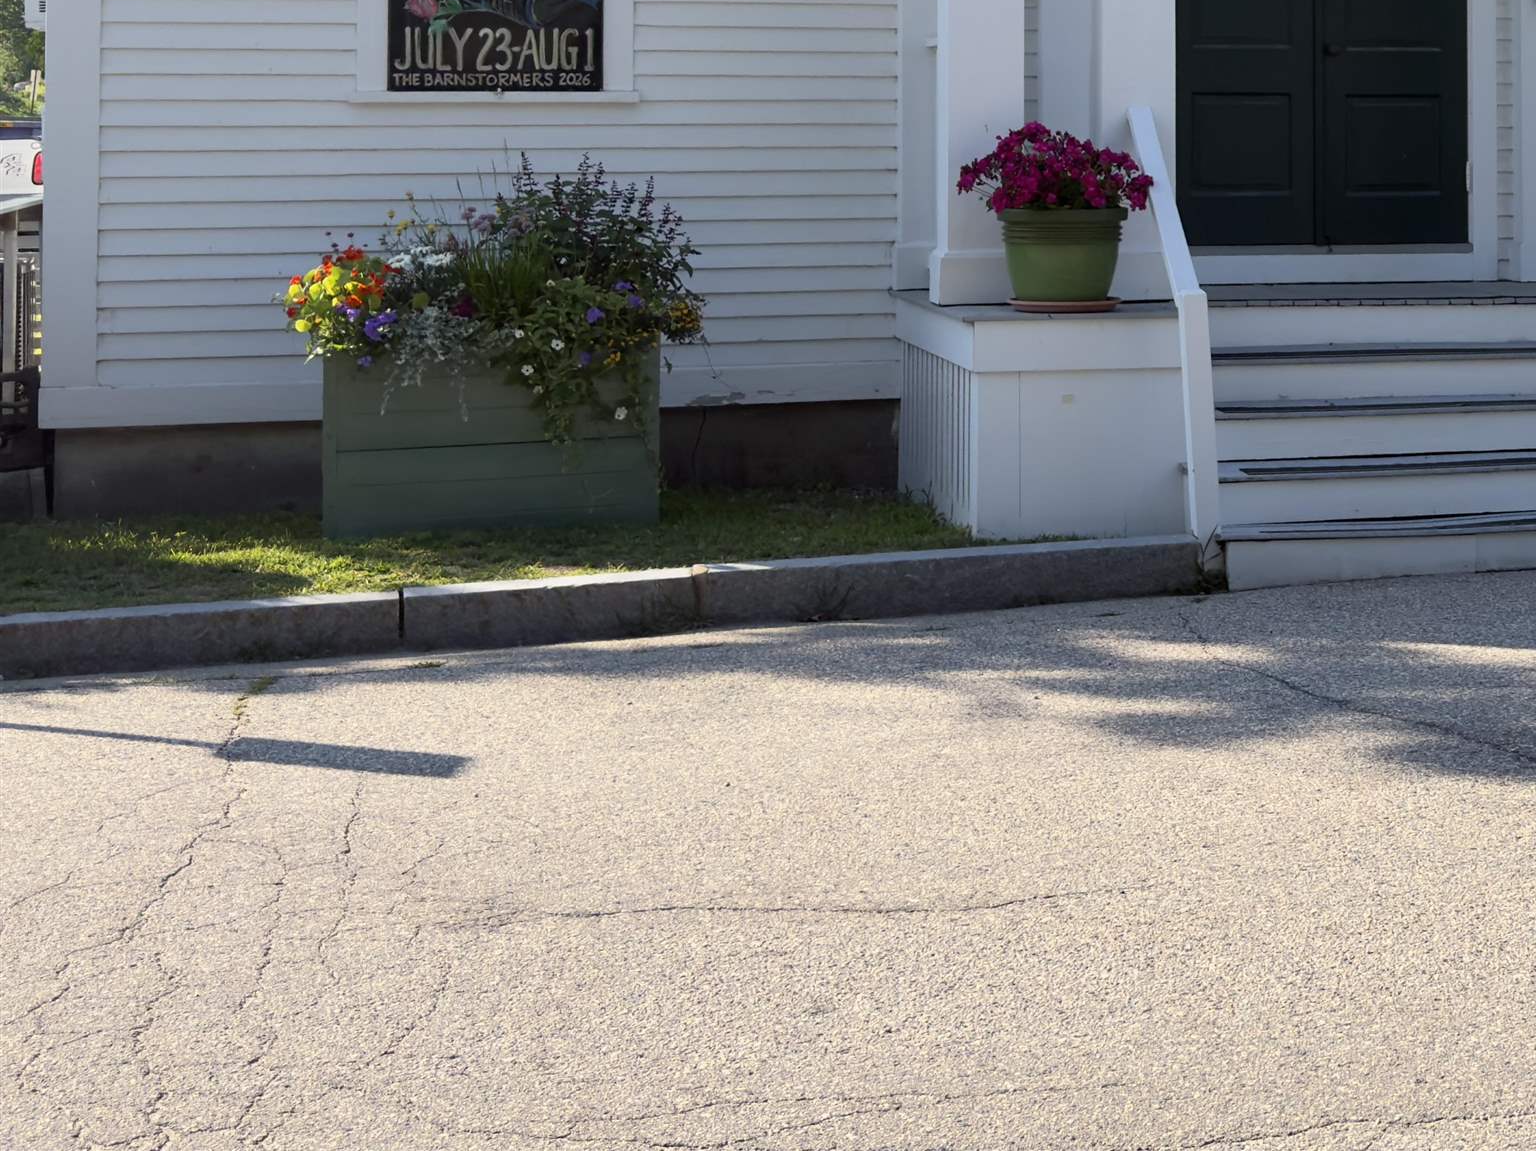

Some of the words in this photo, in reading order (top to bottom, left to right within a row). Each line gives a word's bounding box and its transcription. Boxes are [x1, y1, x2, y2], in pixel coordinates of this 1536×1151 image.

[394, 26, 474, 71] JULY
[393, 73, 421, 86] THE
[424, 73, 554, 87] BARNSTORMERS
